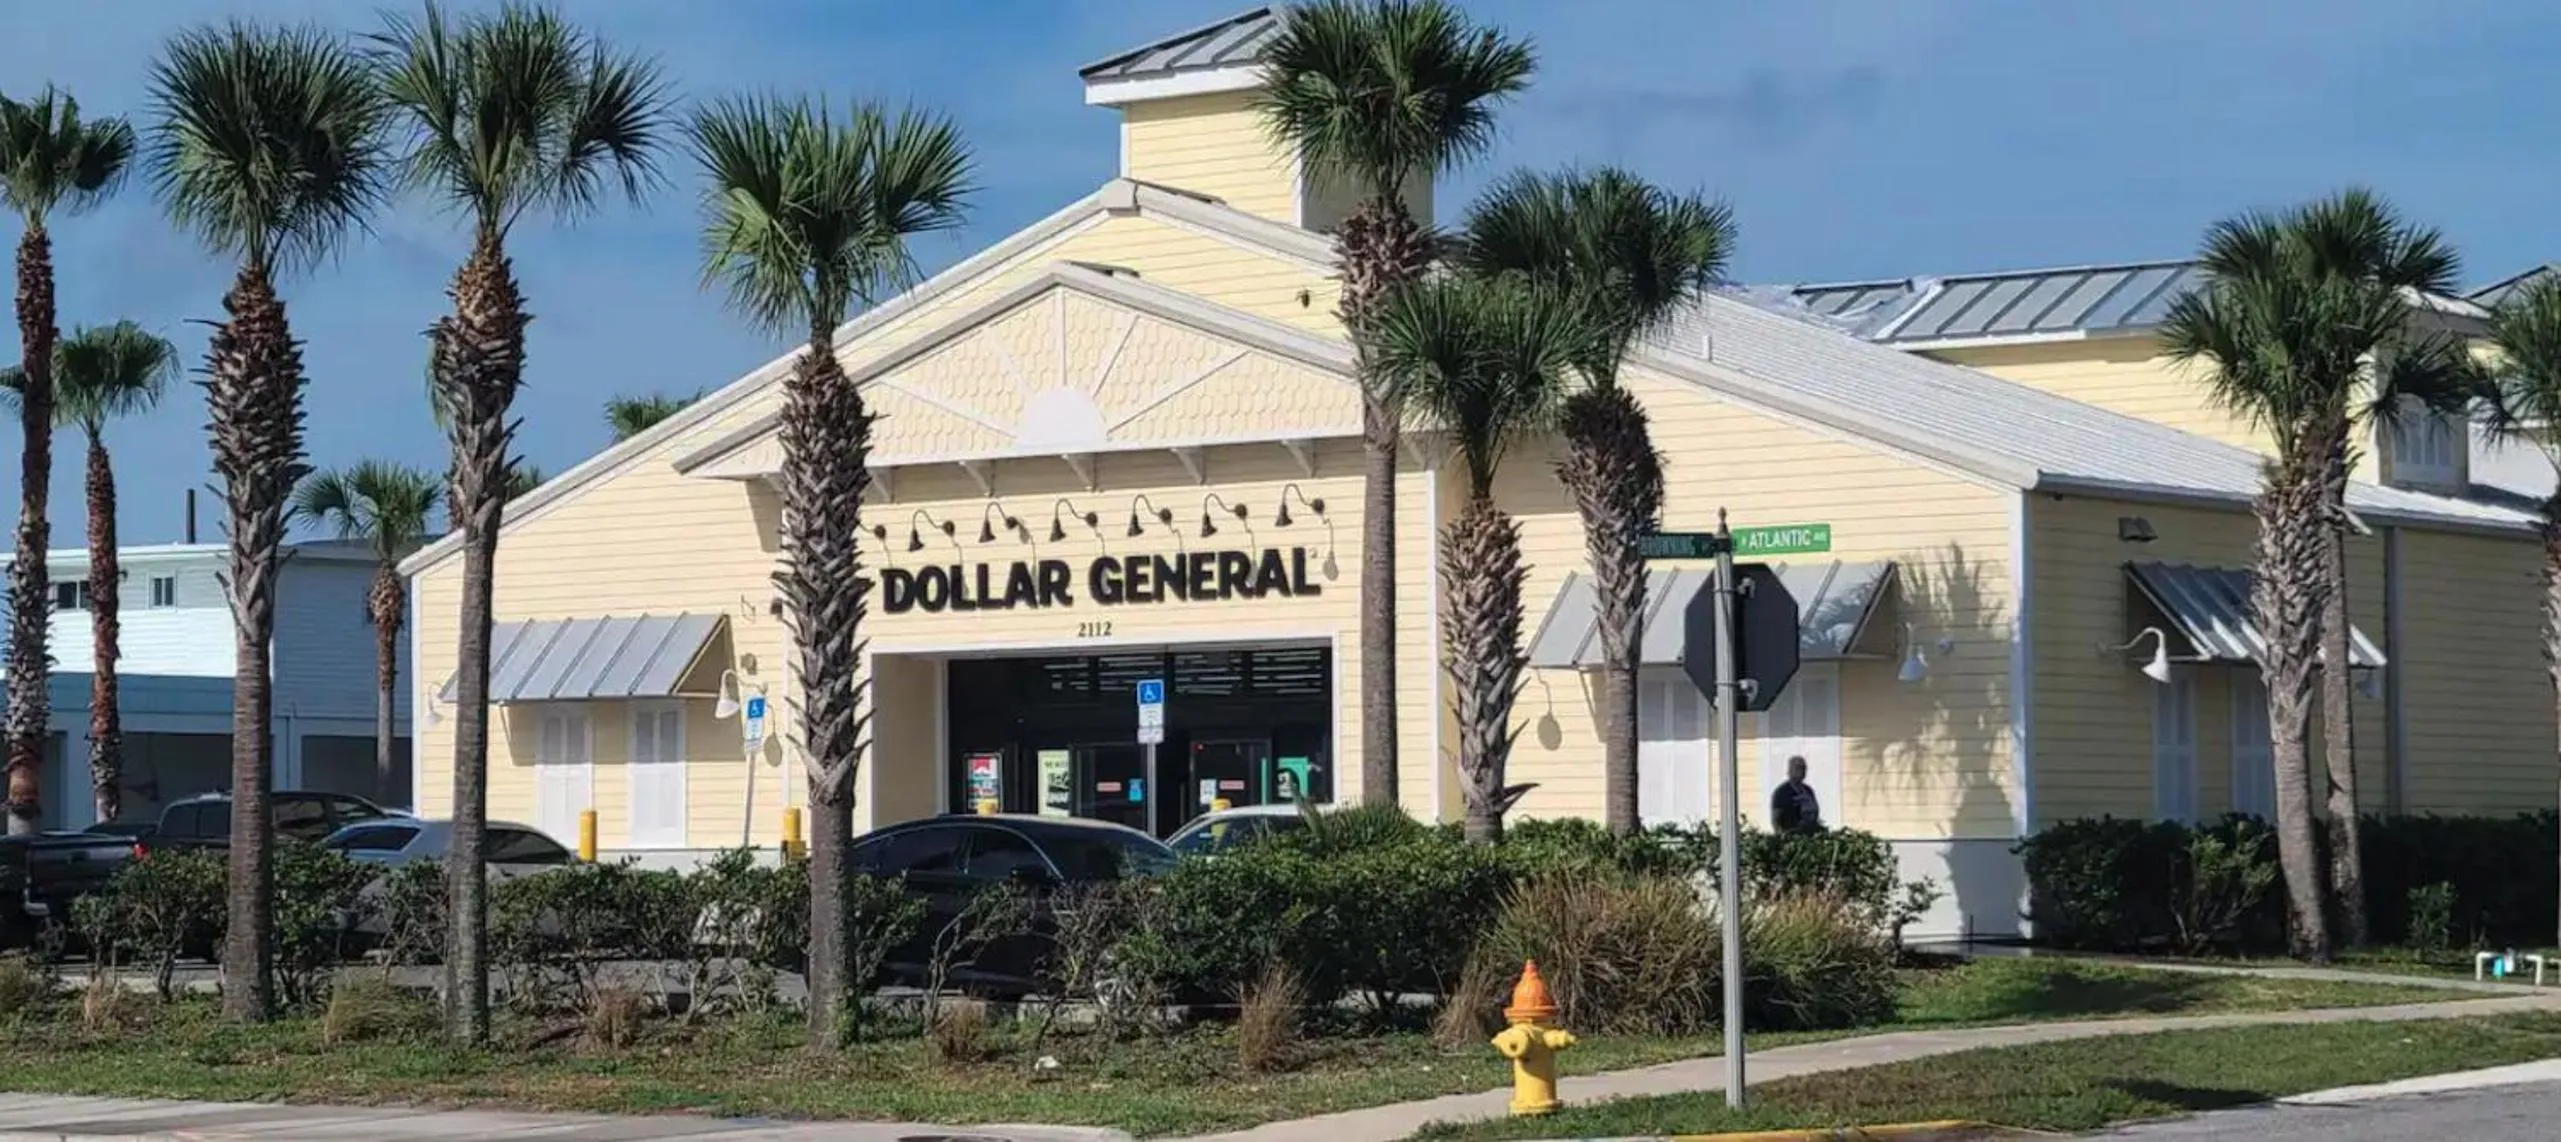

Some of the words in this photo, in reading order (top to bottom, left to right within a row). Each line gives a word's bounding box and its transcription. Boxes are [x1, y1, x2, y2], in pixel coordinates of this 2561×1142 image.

[1748, 528, 1812, 551] ATLANTIC
[880, 559, 1074, 614] DOLLAR
[1088, 547, 1322, 606] GENERAL
[1077, 621, 1112, 638] 2112
